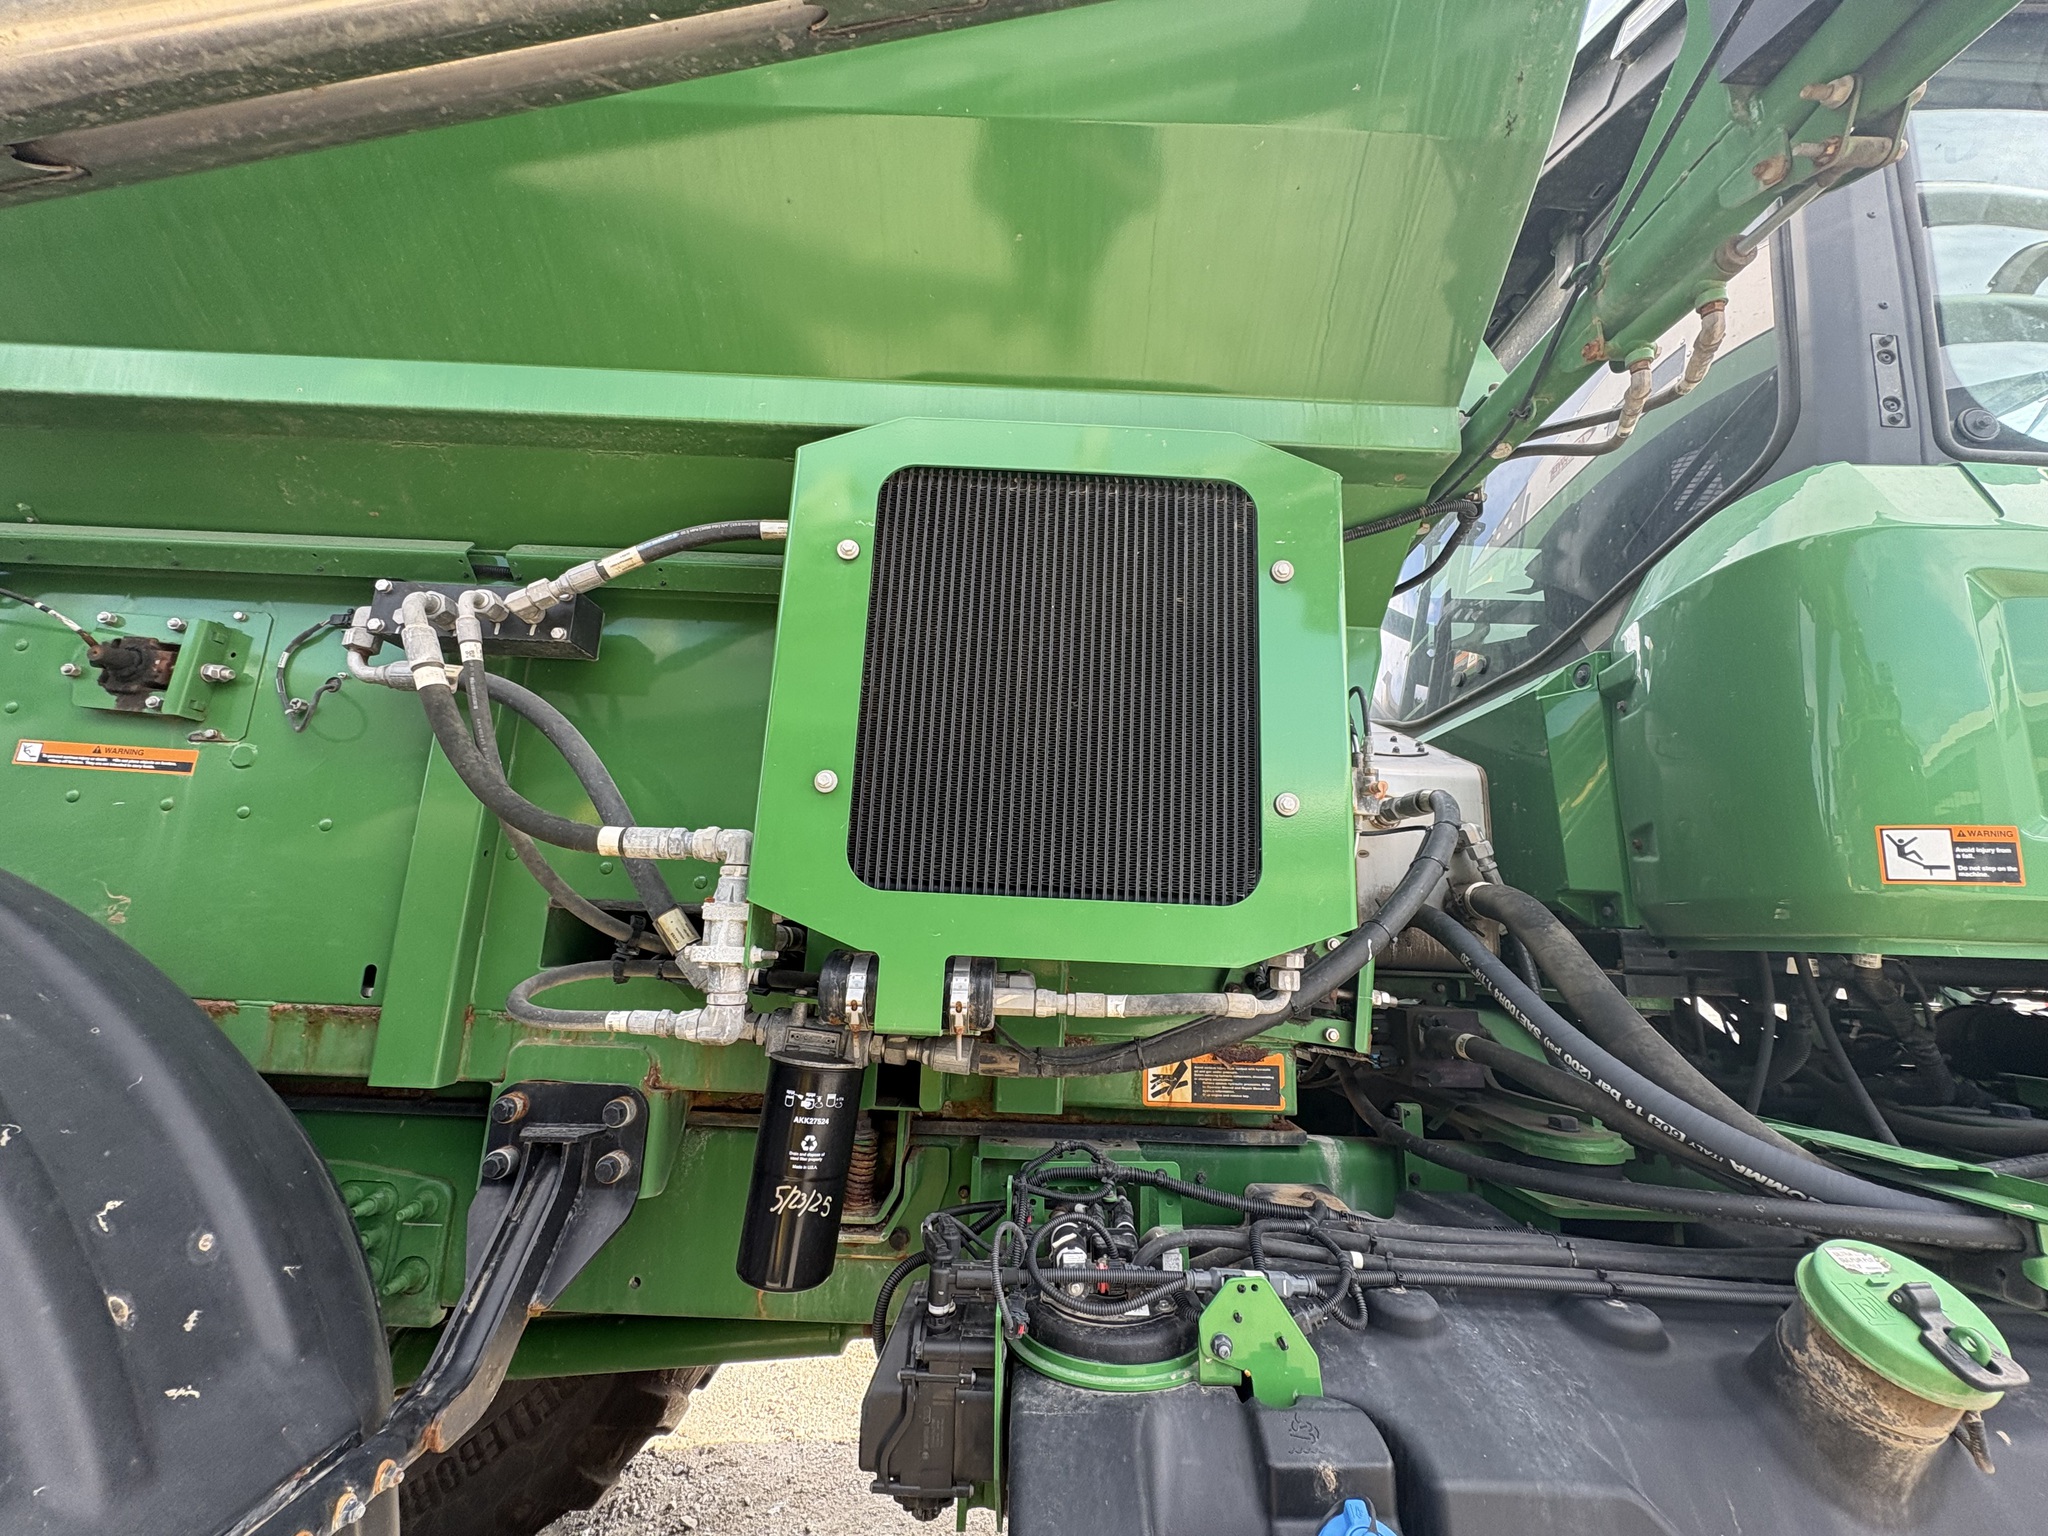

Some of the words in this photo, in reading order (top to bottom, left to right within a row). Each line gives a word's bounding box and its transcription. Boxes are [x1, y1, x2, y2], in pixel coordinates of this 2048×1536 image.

[104, 747, 145, 756] WARNING
[1966, 830, 2014, 838] WARNING
[1976, 847, 1995, 855] injury
[1493, 988, 1542, 1040] SAE100R4
[1543, 1036, 1562, 1056] psi)
[1563, 1053, 1592, 1080] (200
[1594, 1078, 1621, 1101] bar
[1625, 1099, 1644, 1117] 14
[793, 1116, 830, 1125] AKK27524
[1649, 1115, 1686, 1143] 604
[1688, 1141, 1723, 1163] ITALY
[1729, 1158, 1818, 1202] OMMA
[770, 1185, 833, 1218] 5/23/25
